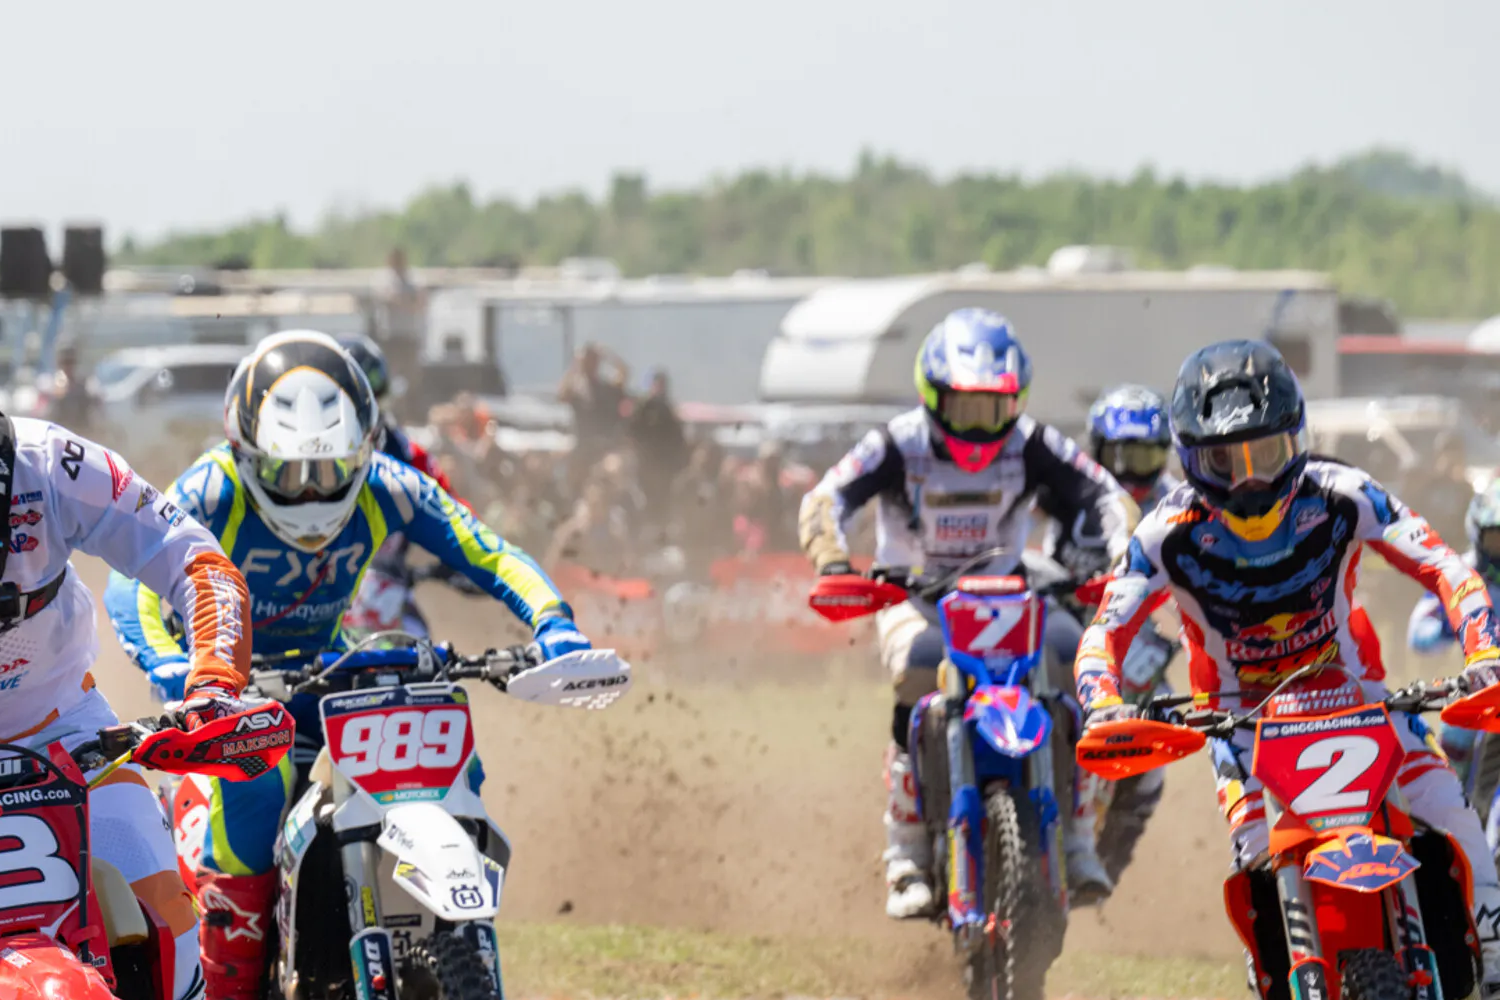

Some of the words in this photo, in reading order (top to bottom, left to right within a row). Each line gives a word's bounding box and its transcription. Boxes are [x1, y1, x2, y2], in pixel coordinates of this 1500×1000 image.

[1225, 638, 1284, 662] Red
[1286, 609, 1336, 654] Bull
[562, 675, 629, 692] ACERBIS
[235, 710, 284, 732] ASV
[222, 730, 291, 757] MAKSON
[338, 709, 467, 778] 989
[1289, 735, 1380, 816] 2
